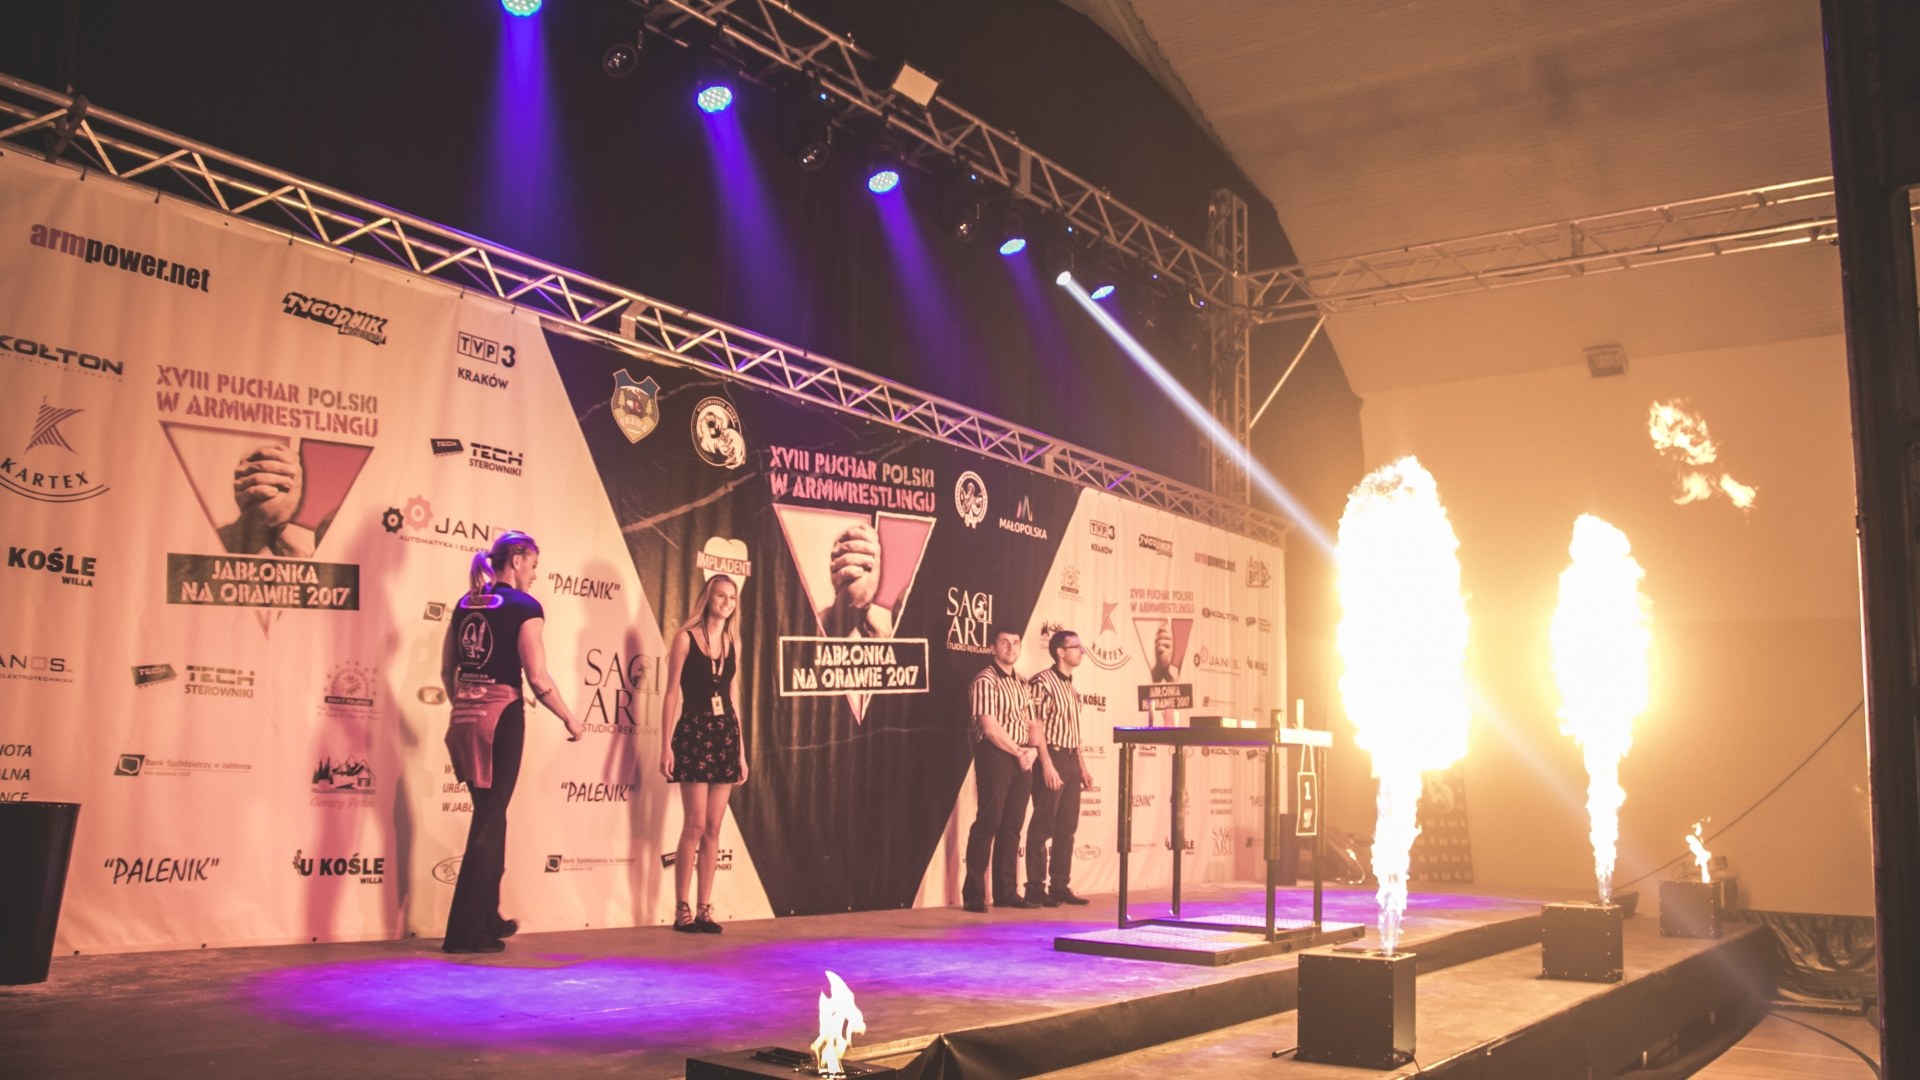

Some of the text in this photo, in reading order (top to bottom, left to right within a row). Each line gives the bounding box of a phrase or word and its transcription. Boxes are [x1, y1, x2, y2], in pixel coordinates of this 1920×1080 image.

[30, 224, 209, 292] armpower.net
[282, 292, 388, 334] TYGODNIK
[157, 365, 378, 414] XVIII PUCHAR POLSKI
[458, 367, 509, 389] KRAKÓW
[157, 391, 379, 438] W ARMWRESTLINGU
[469, 458, 522, 476] STEROWNIKI
[470, 442, 524, 467] TECH
[769, 445, 935, 489] XVIII PUCHAR POLSKI
[1, 457, 89, 489] KARTEX
[770, 472, 789, 496] W
[792, 476, 936, 513] ARMWRESTLINGU
[999, 517, 1048, 540] MAŁOPOLSKA
[400, 535, 453, 549] AUTOMATYKA
[8, 547, 97, 577] KOŚLE
[212, 560, 319, 585] JABŁONKA
[697, 551, 751, 575] IMPLADENT
[62, 576, 93, 587] WILLA
[181, 581, 350, 606] NA ORAWIE 2017
[947, 586, 993, 624] SAGI
[947, 616, 993, 648] ART
[815, 645, 897, 667] JABŁONKA
[1091, 641, 1124, 661] KARTEX
[186, 664, 255, 687] TECH
[793, 665, 919, 690] NA ORAWIE 2017
[184, 685, 254, 699] STEROWNIKI
[1083, 692, 1106, 706] KOŚLE
[583, 688, 660, 727] ART
[582, 722, 616, 735] STUDIO
[319, 852, 385, 875] KOŚLE
